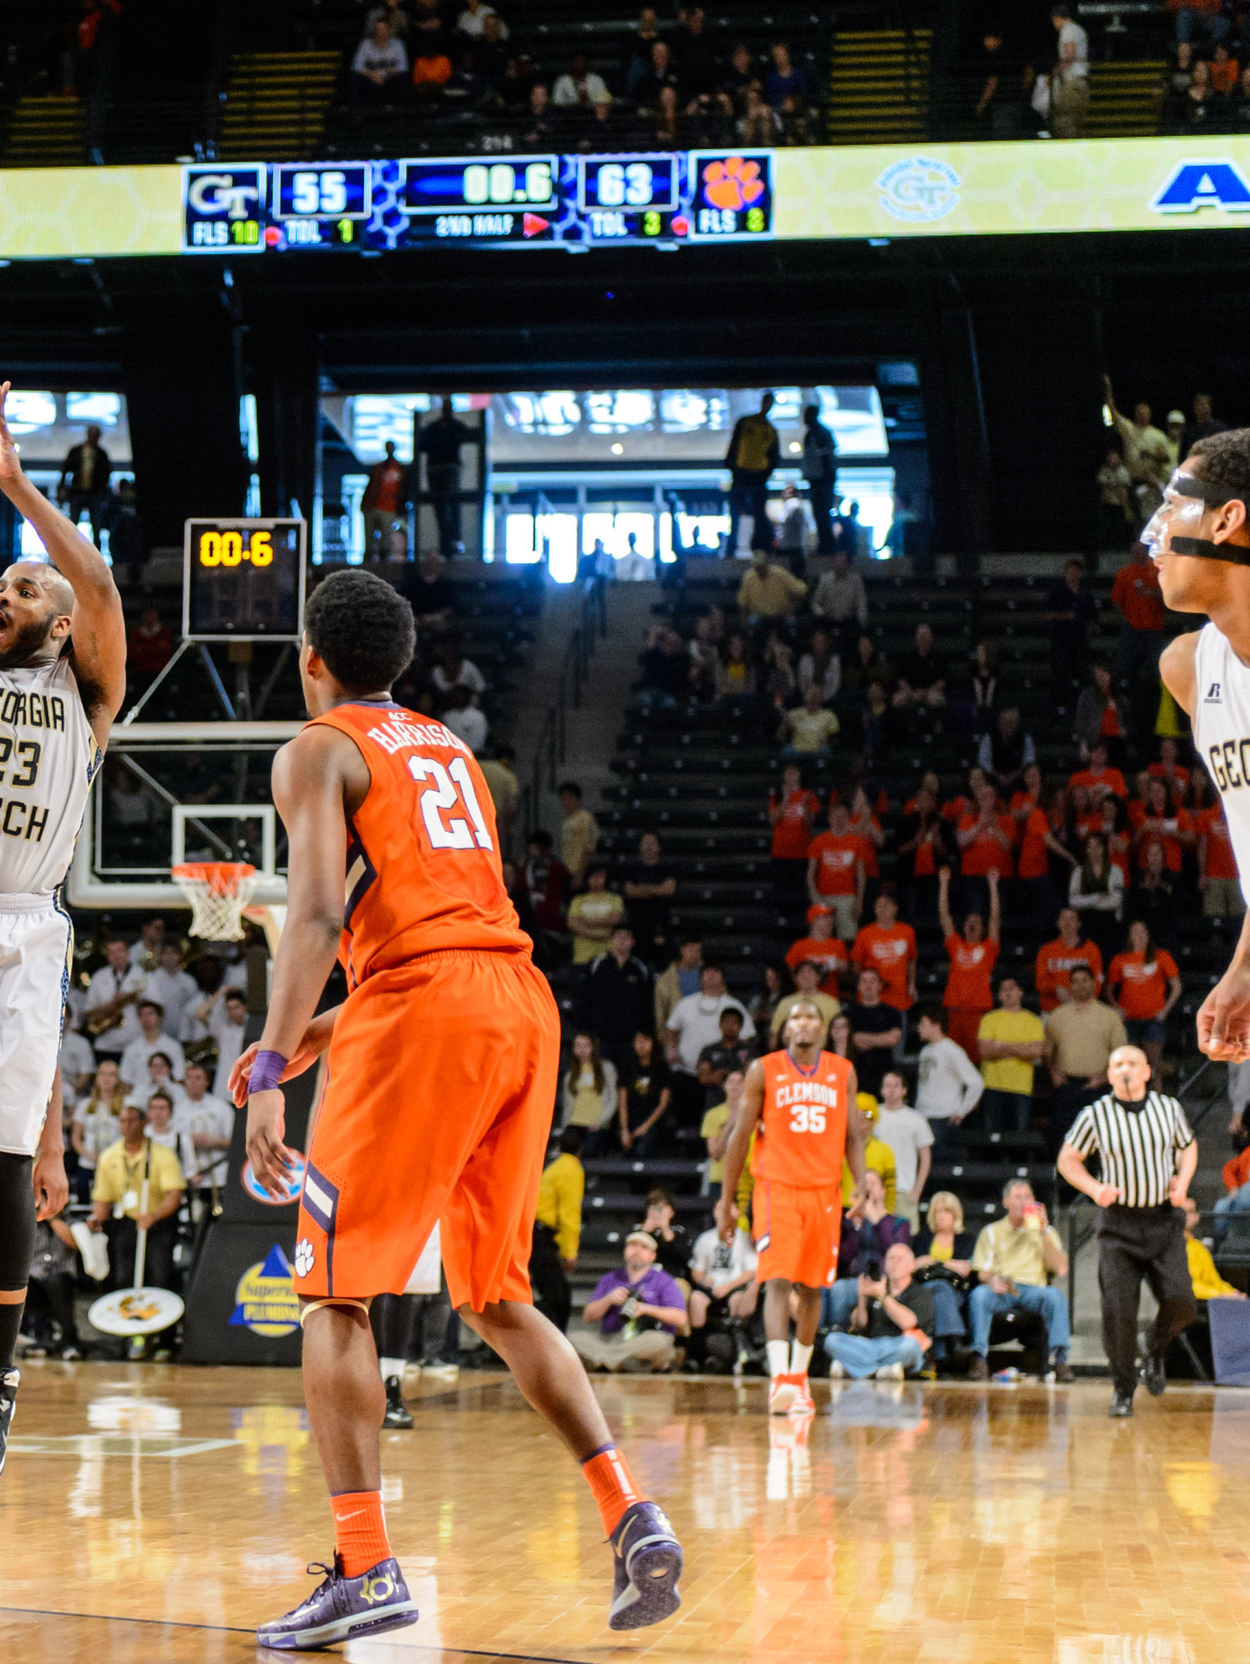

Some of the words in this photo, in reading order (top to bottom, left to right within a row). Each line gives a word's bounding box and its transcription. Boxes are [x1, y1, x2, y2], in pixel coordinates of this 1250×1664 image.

[292, 171, 348, 214] 55
[463, 162, 553, 205] 00.6
[597, 163, 653, 206] 63
[232, 220, 260, 245] 10
[337, 219, 354, 244] 1
[199, 530, 274, 567] 00.6
[407, 755, 494, 852] 21
[775, 1081, 838, 1109] CLEMSON
[789, 1104, 827, 1134] 35
